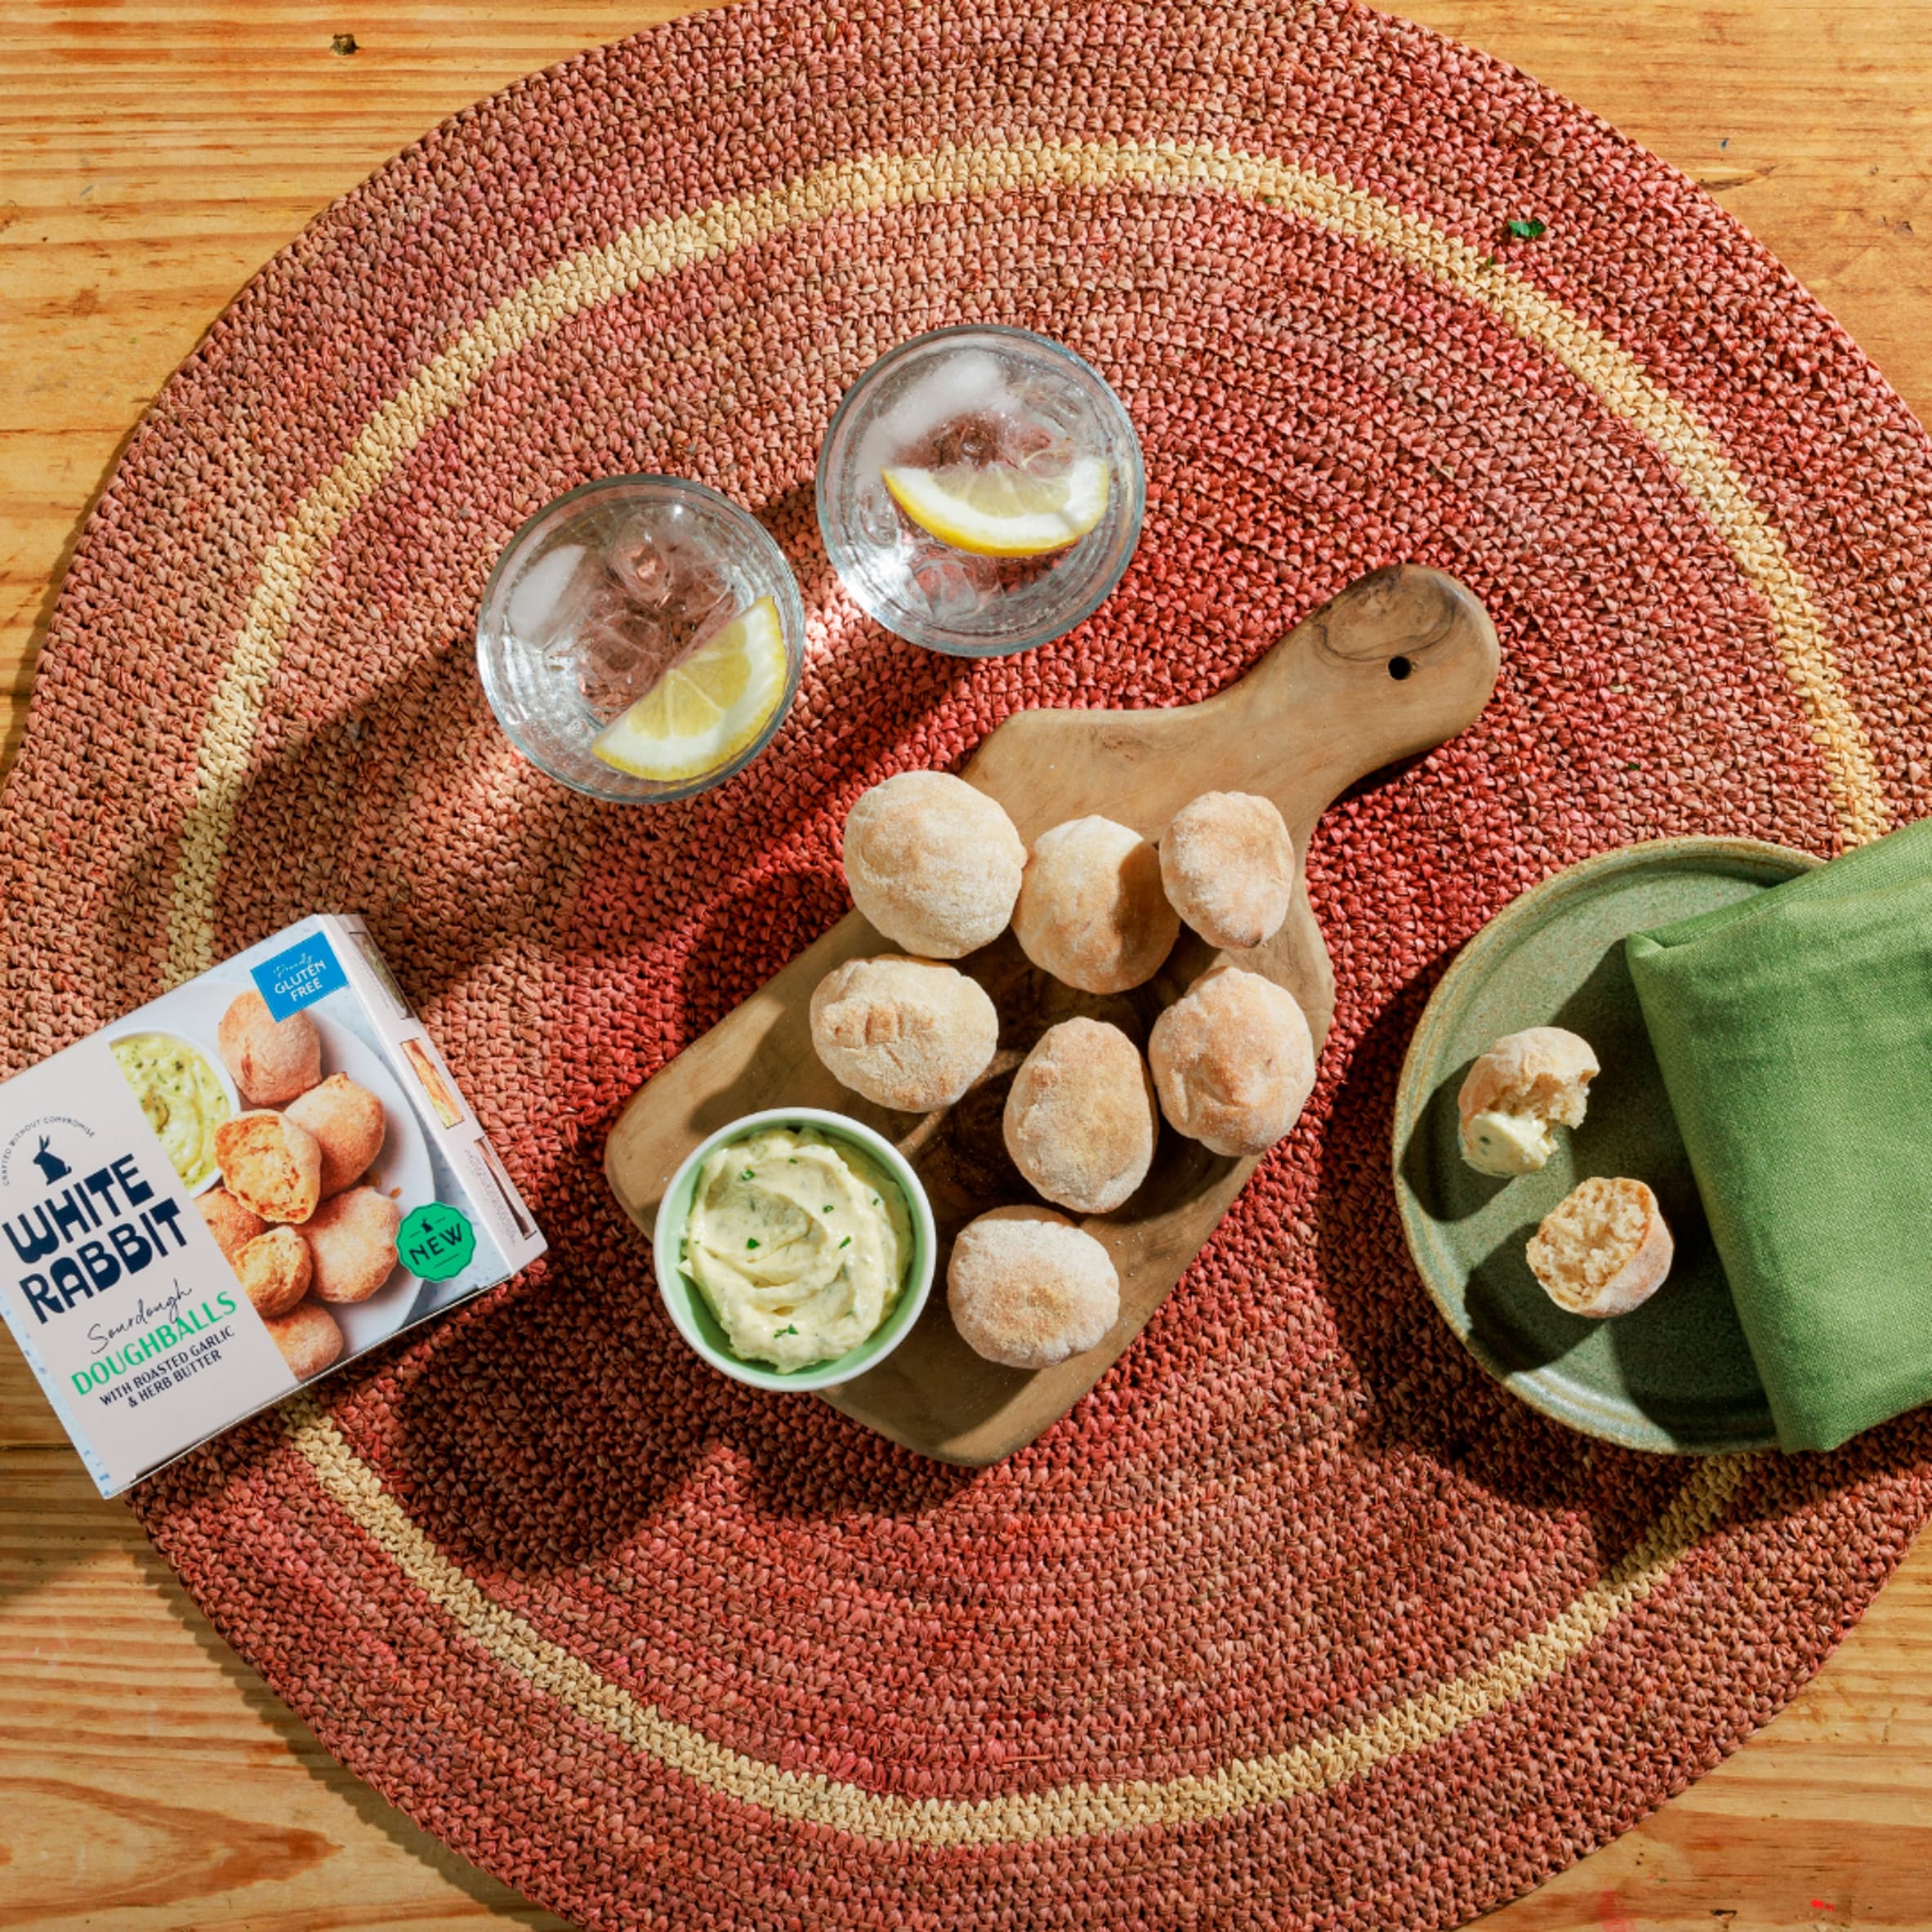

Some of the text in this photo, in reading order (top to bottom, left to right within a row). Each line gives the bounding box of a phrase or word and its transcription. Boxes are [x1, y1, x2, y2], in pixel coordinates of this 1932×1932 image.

[274, 960, 326, 994] GLUTEN
[290, 978, 323, 1002] FREE
[3, 1153, 154, 1264] WHITE
[409, 1223, 462, 1265] NEW
[19, 1197, 187, 1324] RABBIT
[71, 1291, 237, 1396] DOUGHBALLS
[87, 1278, 192, 1354] Sourdough
[100, 1325, 235, 1406] WITH ROASTED GARLIC
[128, 1349, 222, 1408] & HERB BUTTER
